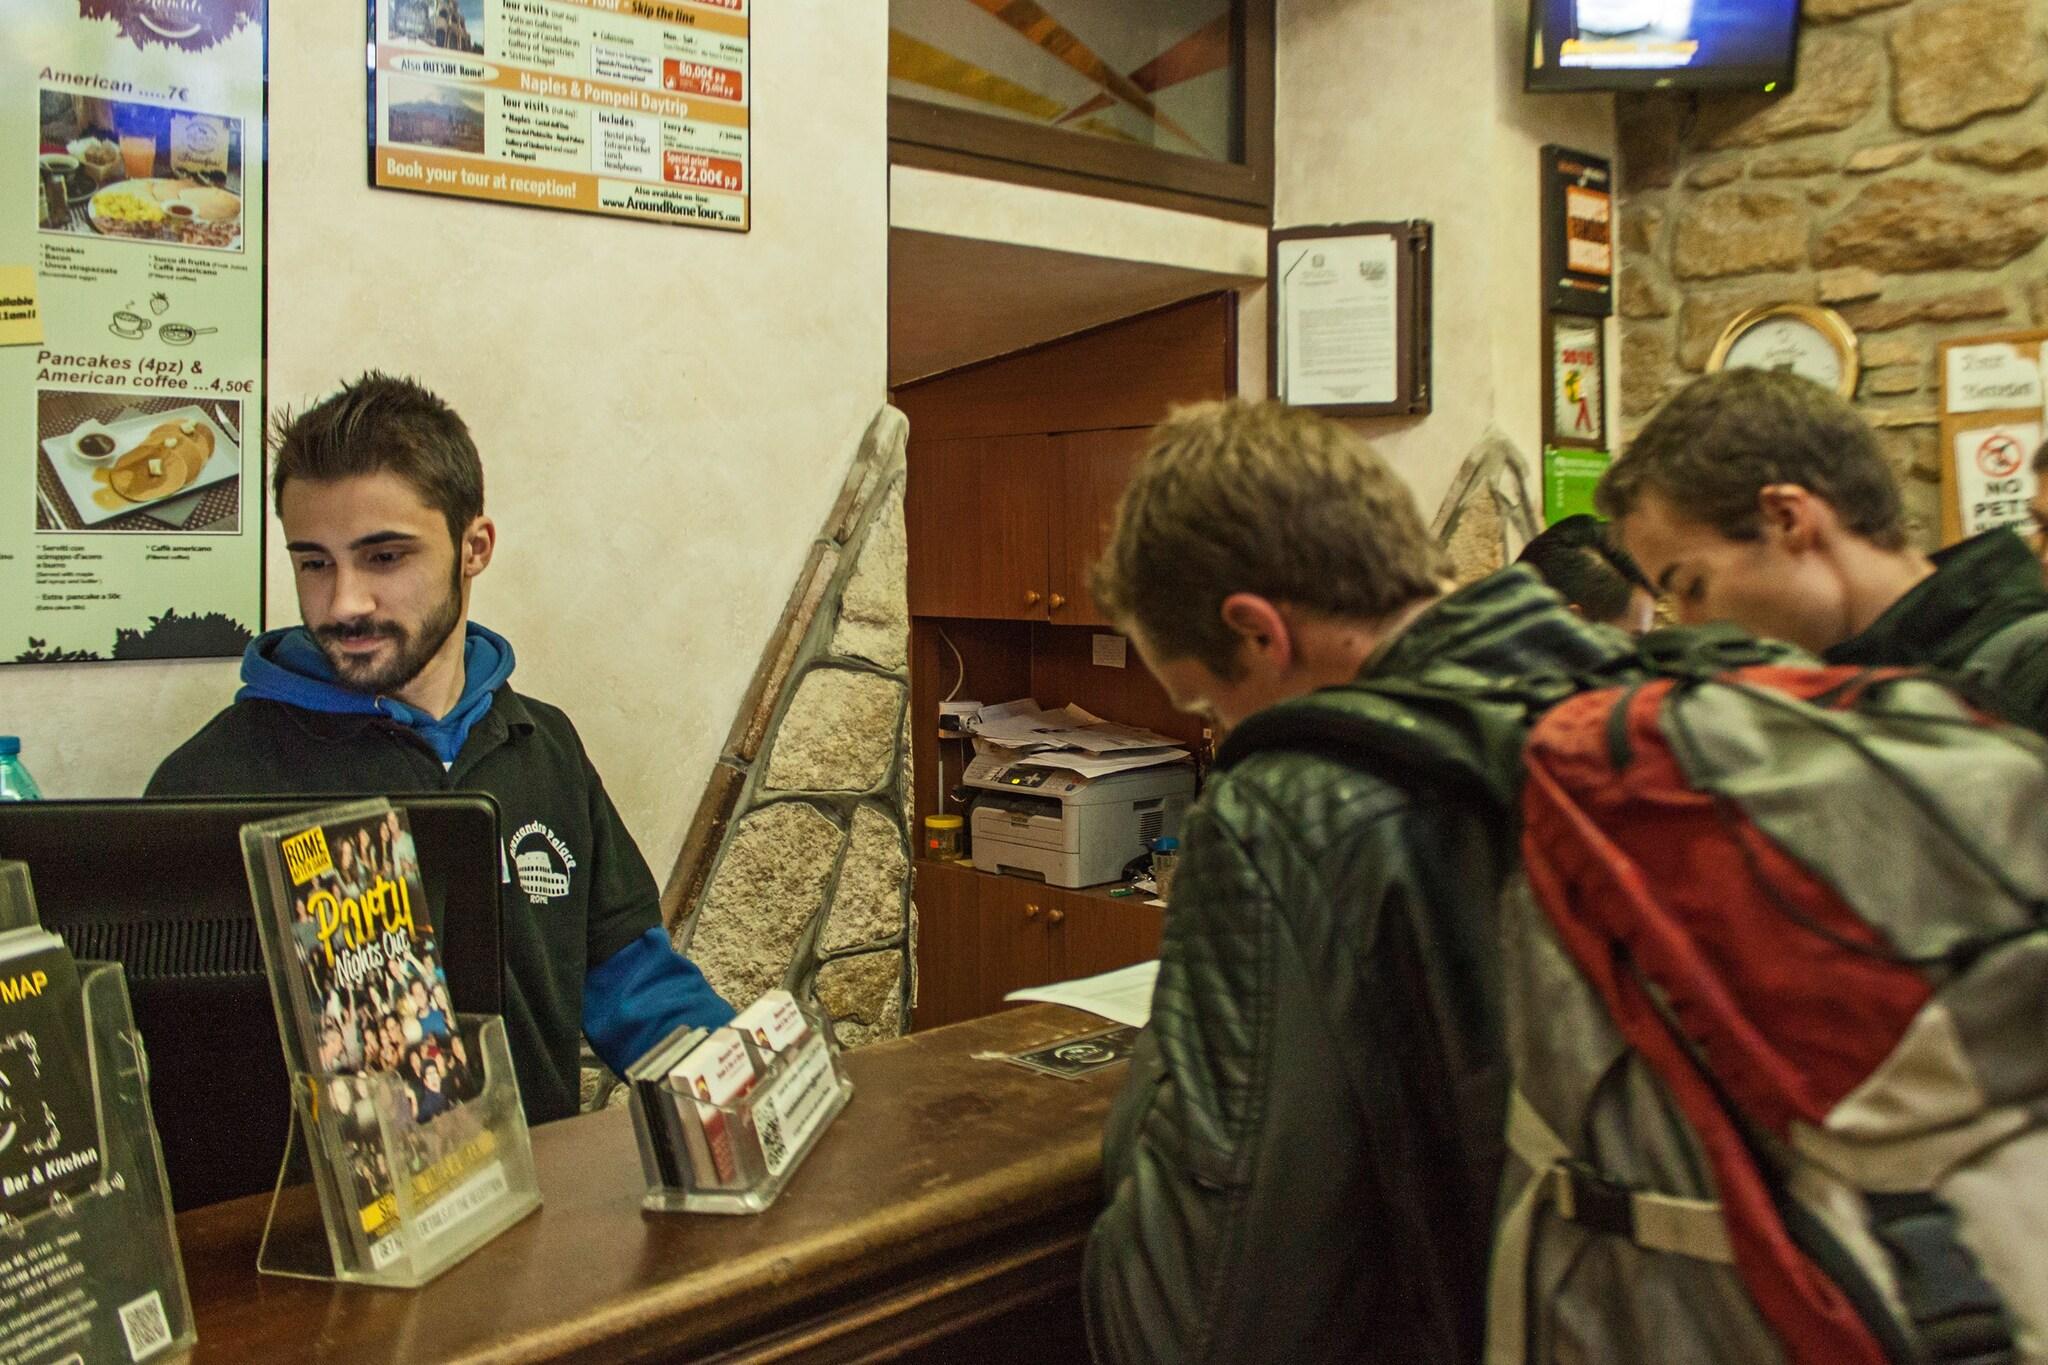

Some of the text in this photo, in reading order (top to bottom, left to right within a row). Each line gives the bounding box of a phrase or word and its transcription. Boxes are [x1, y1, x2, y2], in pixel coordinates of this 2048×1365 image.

[524, 3, 549, 16] visits
[632, 0, 653, 18] Skip
[656, 6, 673, 19] the
[675, 8, 695, 24] line
[508, 27, 530, 39] Gallery
[533, 31, 539, 39] of
[508, 39, 530, 52] Gallery
[533, 43, 539, 51] of
[401, 58, 485, 78] Also OUTSIDE Rome!
[39, 66, 134, 94] American
[502, 94, 521, 108] Tour
[523, 98, 550, 113] visits
[520, 71, 689, 117] Naples & Pompeii Daytrip
[509, 113, 531, 125] Naples
[510, 149, 537, 162] Pompeii
[387, 157, 577, 198] Book your tour at reception!
[673, 163, 723, 186] 122,00€
[634, 186, 651, 196] Also
[651, 189, 684, 200] available
[45, 244, 85, 255] Pancakes
[175, 267, 218, 276] americano
[187, 258, 211, 267] frutta
[37, 351, 203, 375] Pancakes (4pz) &
[36, 368, 127, 386] American
[132, 373, 188, 390] coffee
[285, 832, 324, 868] ROME
[547, 829, 577, 869] Palace
[529, 894, 549, 905] ROME
[307, 873, 419, 970] Party
[335, 926, 411, 989] Nights Out
[0, 969, 48, 1005] MAP
[3, 1174, 31, 1198] Bar
[45, 1148, 98, 1180] Kitchen
